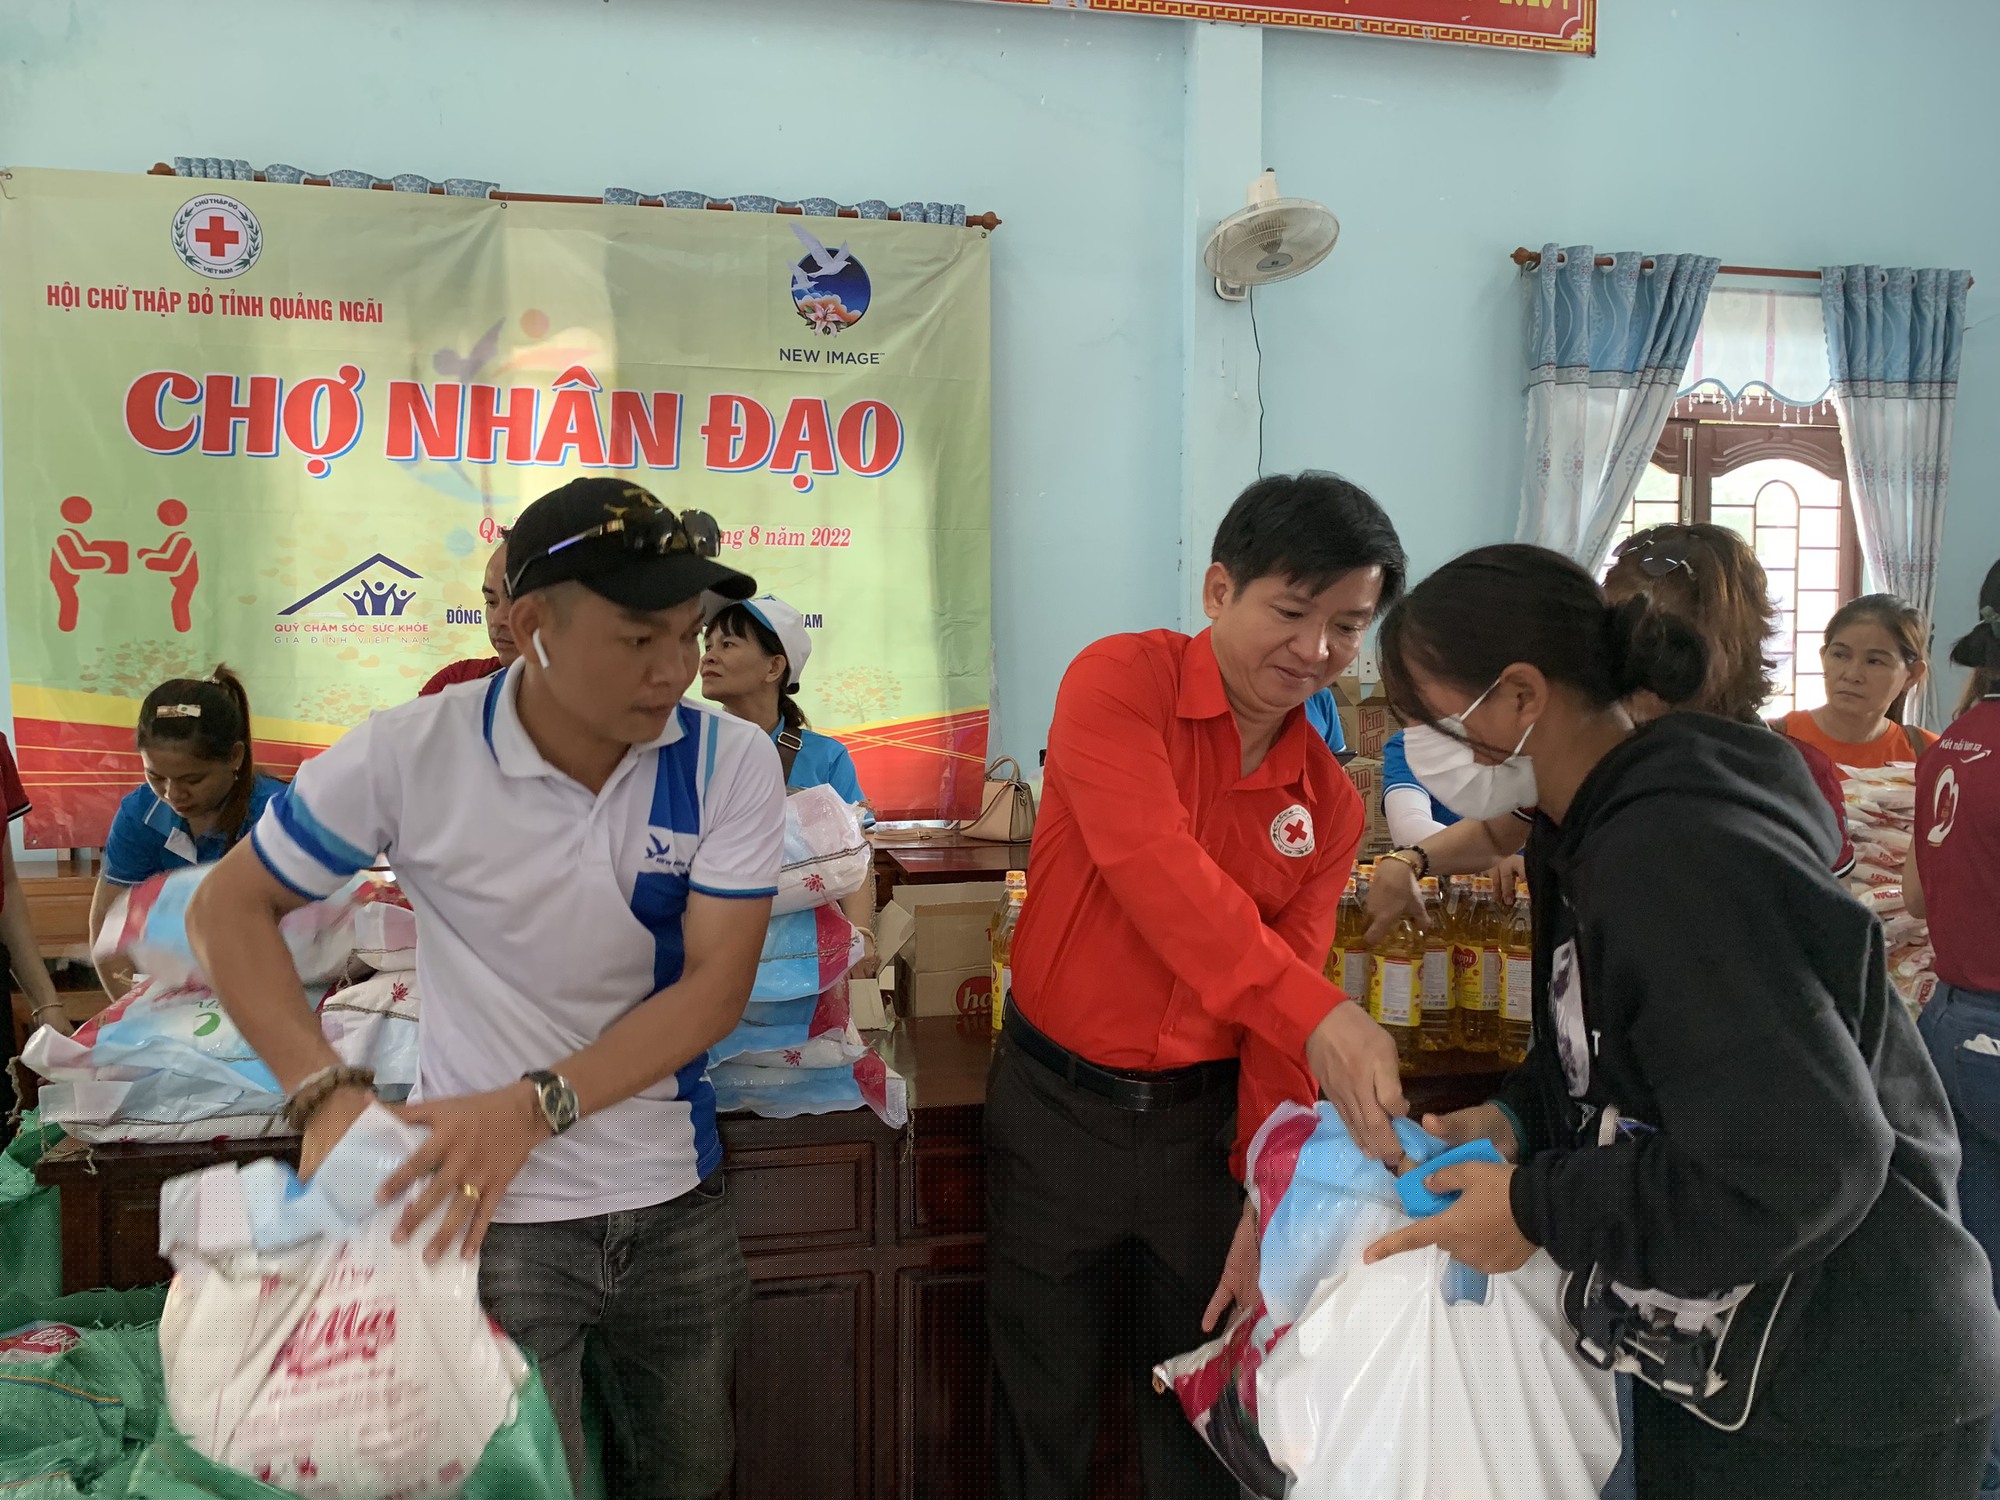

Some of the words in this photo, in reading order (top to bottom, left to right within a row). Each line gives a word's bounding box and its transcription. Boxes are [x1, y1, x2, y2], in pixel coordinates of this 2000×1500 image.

[47, 281, 80, 312] HỘI
[87, 285, 129, 310] CHỮ
[132, 287, 181, 317] THẬP
[187, 287, 214, 315] ĐỎ
[219, 289, 263, 317] TỈNH
[270, 292, 332, 321] QUẢNG
[339, 298, 383, 323] NGÃI
[779, 348, 820, 362] NEW
[124, 364, 366, 479] CHỢ
[384, 363, 684, 470] NHÂN
[700, 393, 904, 493] ĐẠO
[748, 525, 760, 545] 8
[764, 526, 805, 546] năm
[809, 527, 851, 547] 2022
[341, 623, 365, 633] SÓC
[801, 613, 823, 628] AM
[274, 636, 300, 644] GIA
